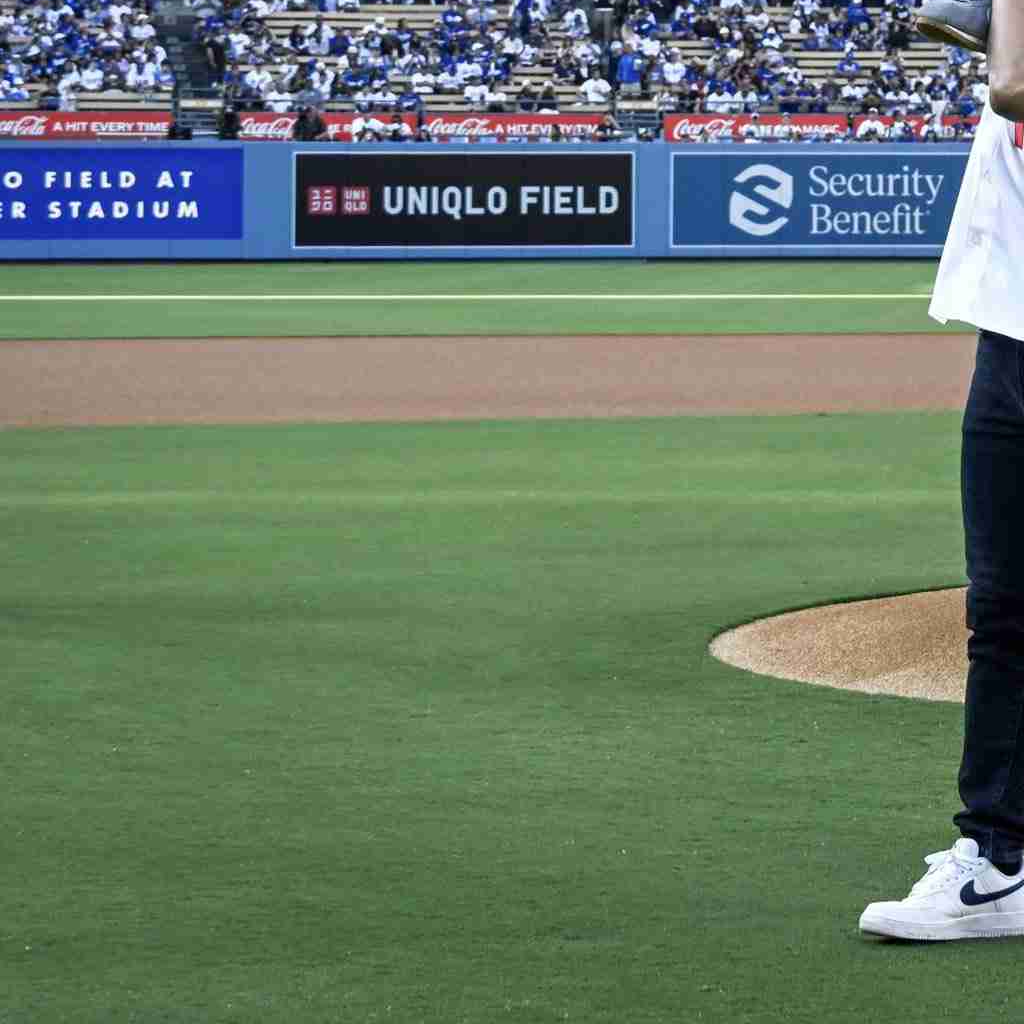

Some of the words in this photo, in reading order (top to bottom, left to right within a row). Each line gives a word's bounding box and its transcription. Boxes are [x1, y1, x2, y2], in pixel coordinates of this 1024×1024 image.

[53, 121, 64, 132] A
[65, 121, 89, 132] HIT
[91, 121, 137, 133] EVERY
[137, 121, 169, 133] TIME
[44, 171, 136, 188] FIELD
[156, 171, 193, 188] AT
[809, 165, 944, 204] Security
[0, 201, 27, 218] R
[48, 201, 199, 218] STADIUM
[383, 186, 507, 220] UNIQLO
[520, 186, 619, 215] FIELD
[809, 203, 926, 235] Benefit
